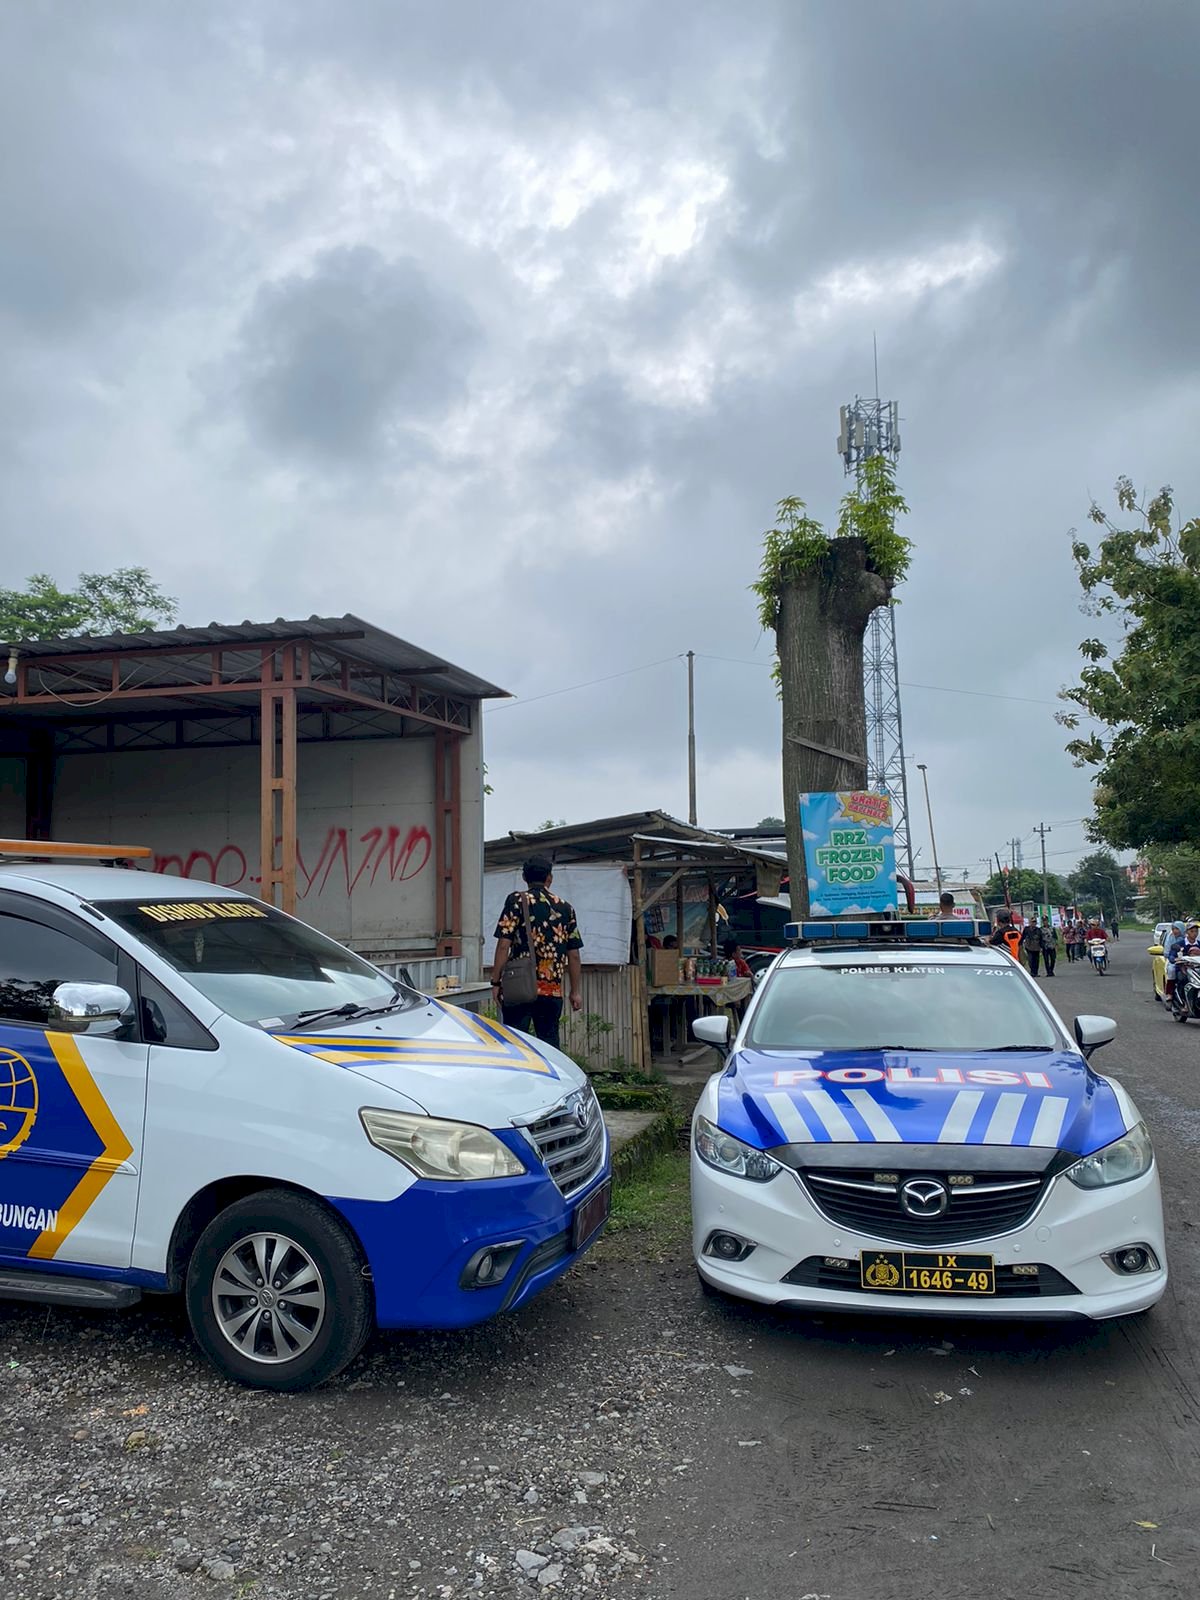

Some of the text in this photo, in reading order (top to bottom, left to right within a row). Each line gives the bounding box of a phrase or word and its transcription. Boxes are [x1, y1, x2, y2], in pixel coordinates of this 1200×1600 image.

[851, 791, 889, 811] GRATIS
[832, 830, 867, 846] RRZ
[817, 847, 883, 865] FROZEN
[828, 866, 876, 882] FOOD
[137, 902, 216, 922] DISHUB
[840, 966, 945, 975] POLRES KLATEN
[974, 968, 1014, 977] 7204
[774, 1068, 1053, 1089] POLISI
[938, 1255, 957, 1267] IX
[909, 1270, 989, 1290] 1646-49
